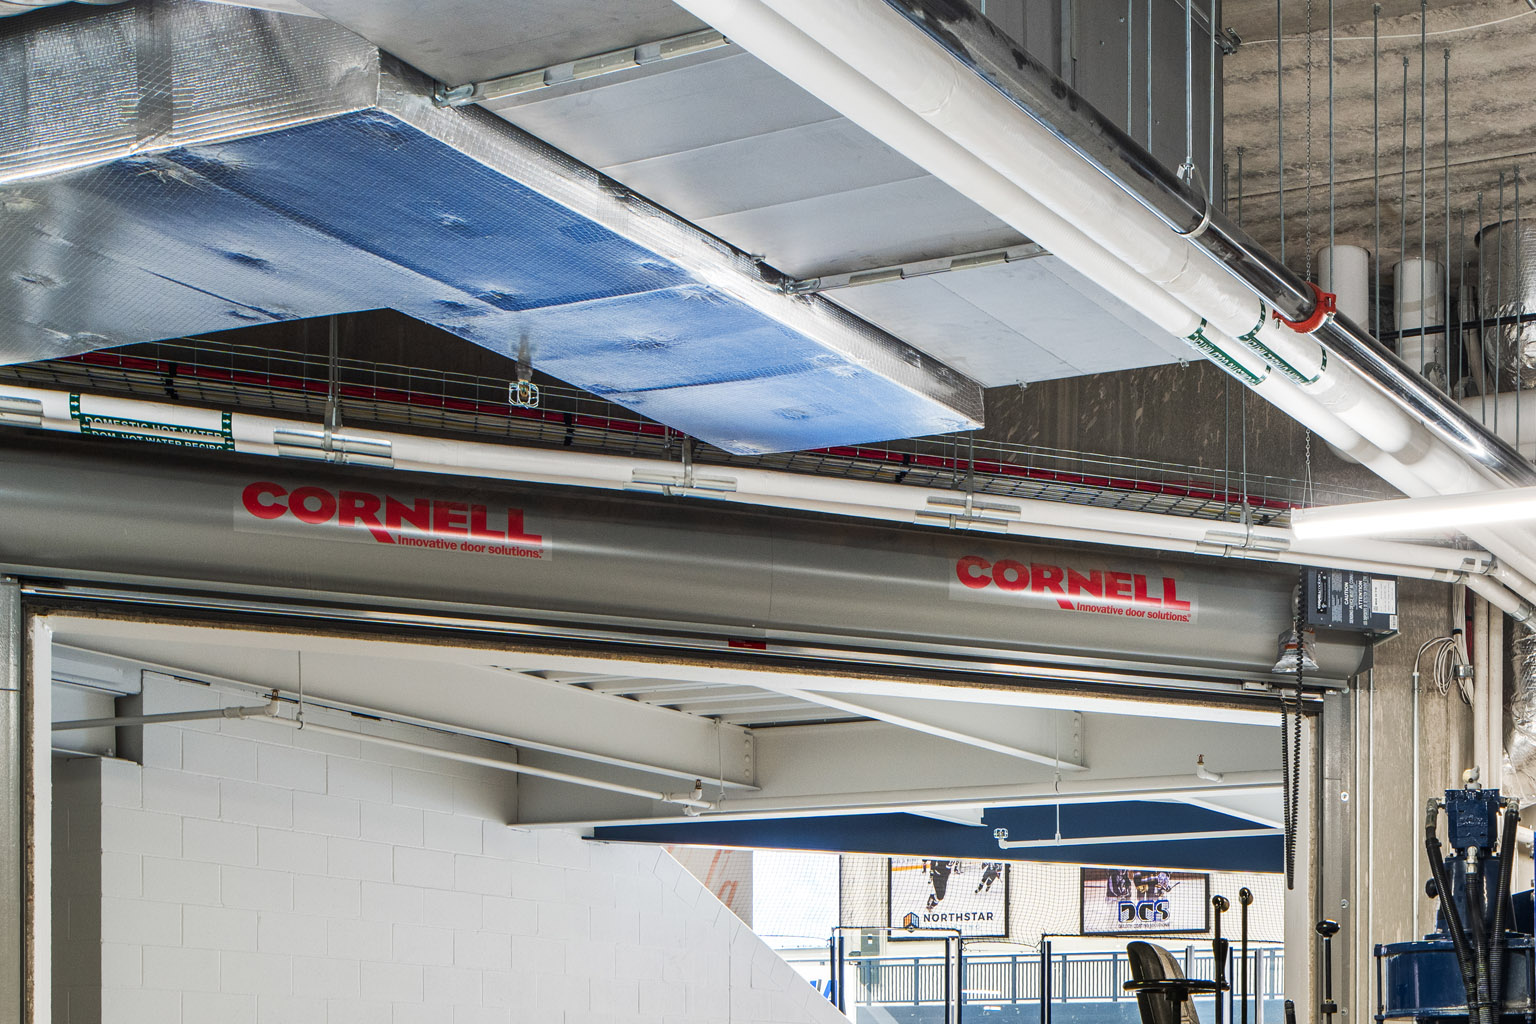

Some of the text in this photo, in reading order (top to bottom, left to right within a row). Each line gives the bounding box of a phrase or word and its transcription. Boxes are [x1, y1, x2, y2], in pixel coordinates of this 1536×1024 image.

[242, 481, 543, 546] CORNELL
[397, 534, 457, 551] Innovative
[460, 540, 486, 554] door
[956, 555, 1191, 611] CORNELL
[1076, 602, 1124, 616] Innovative
[1125, 607, 1146, 619] door
[923, 911, 994, 923] NORTHSTAR
